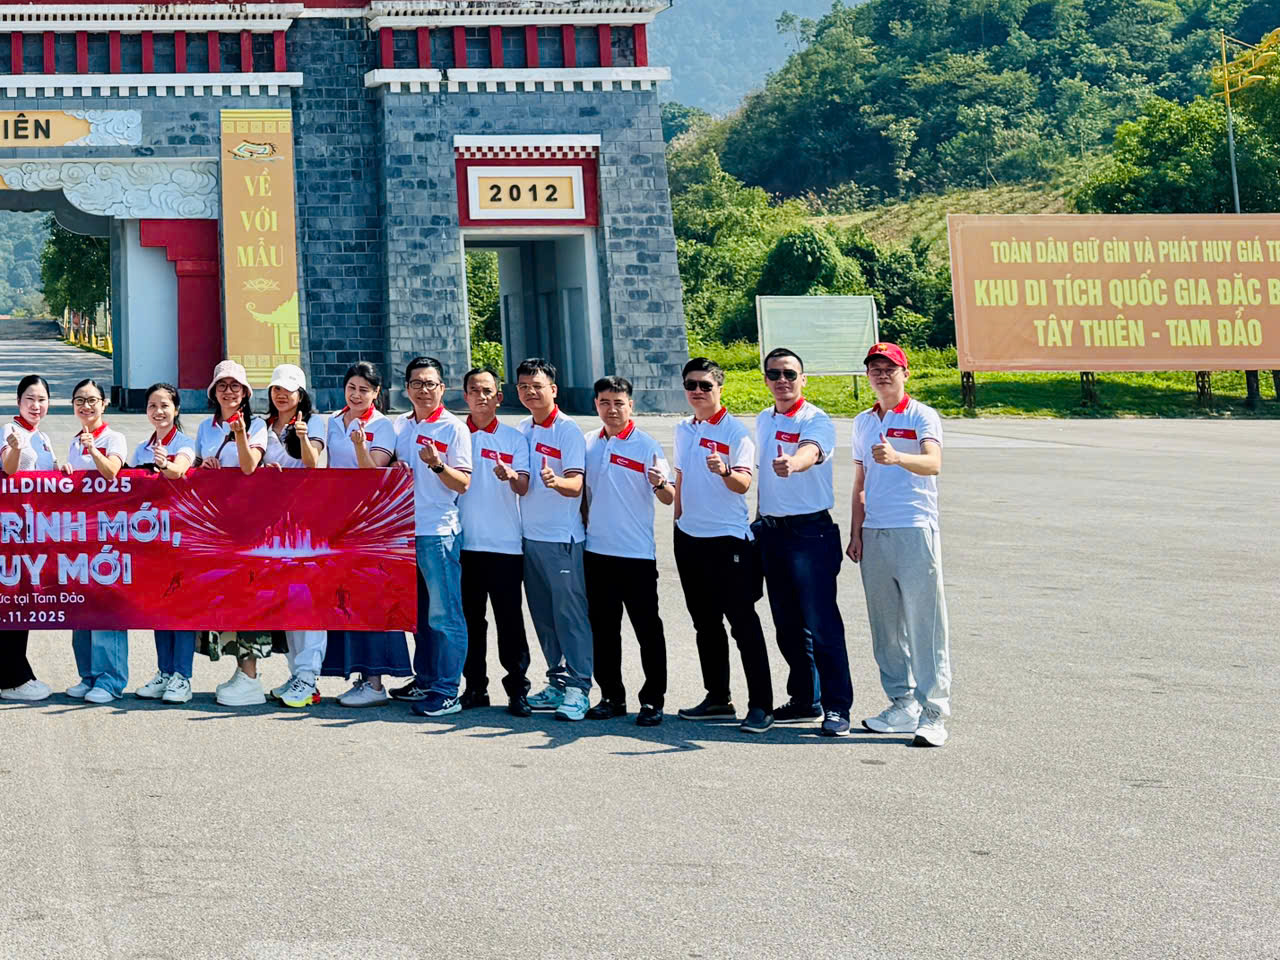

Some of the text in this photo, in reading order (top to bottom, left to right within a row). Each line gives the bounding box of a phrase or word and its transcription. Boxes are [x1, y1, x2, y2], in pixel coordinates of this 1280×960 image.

[489, 184, 558, 202] 2012
[240, 205, 278, 232] VỚI
[236, 237, 284, 268] MẪU
[991, 237, 1033, 264] TOÀN
[1036, 237, 1068, 264] DÂN
[1073, 237, 1100, 264] GIỮ
[1103, 236, 1131, 264] GÌN
[1133, 235, 1155, 264] VÀ
[1159, 236, 1199, 263] PHÁT
[1202, 240, 1232, 263] HUY
[1237, 235, 1264, 262] GIÁ
[974, 279, 1019, 307] KHU
[1024, 279, 1047, 306] DI
[1053, 273, 1103, 307] TÍCH
[1109, 269, 1168, 308] QUỐC
[1174, 279, 1212, 306] GIA
[1034, 313, 1073, 347] TÂY
[1080, 314, 1145, 347] THIÊN
[1165, 319, 1212, 347] TAM
[1217, 310, 1263, 347] ĐẢO
[82, 476, 132, 494] 2025
[98, 502, 183, 548] MỚI,
[58, 545, 132, 585] MỚI
[14, 592, 30, 607] tại
[32, 593, 57, 604] Tam
[60, 591, 86, 604] Đảo
